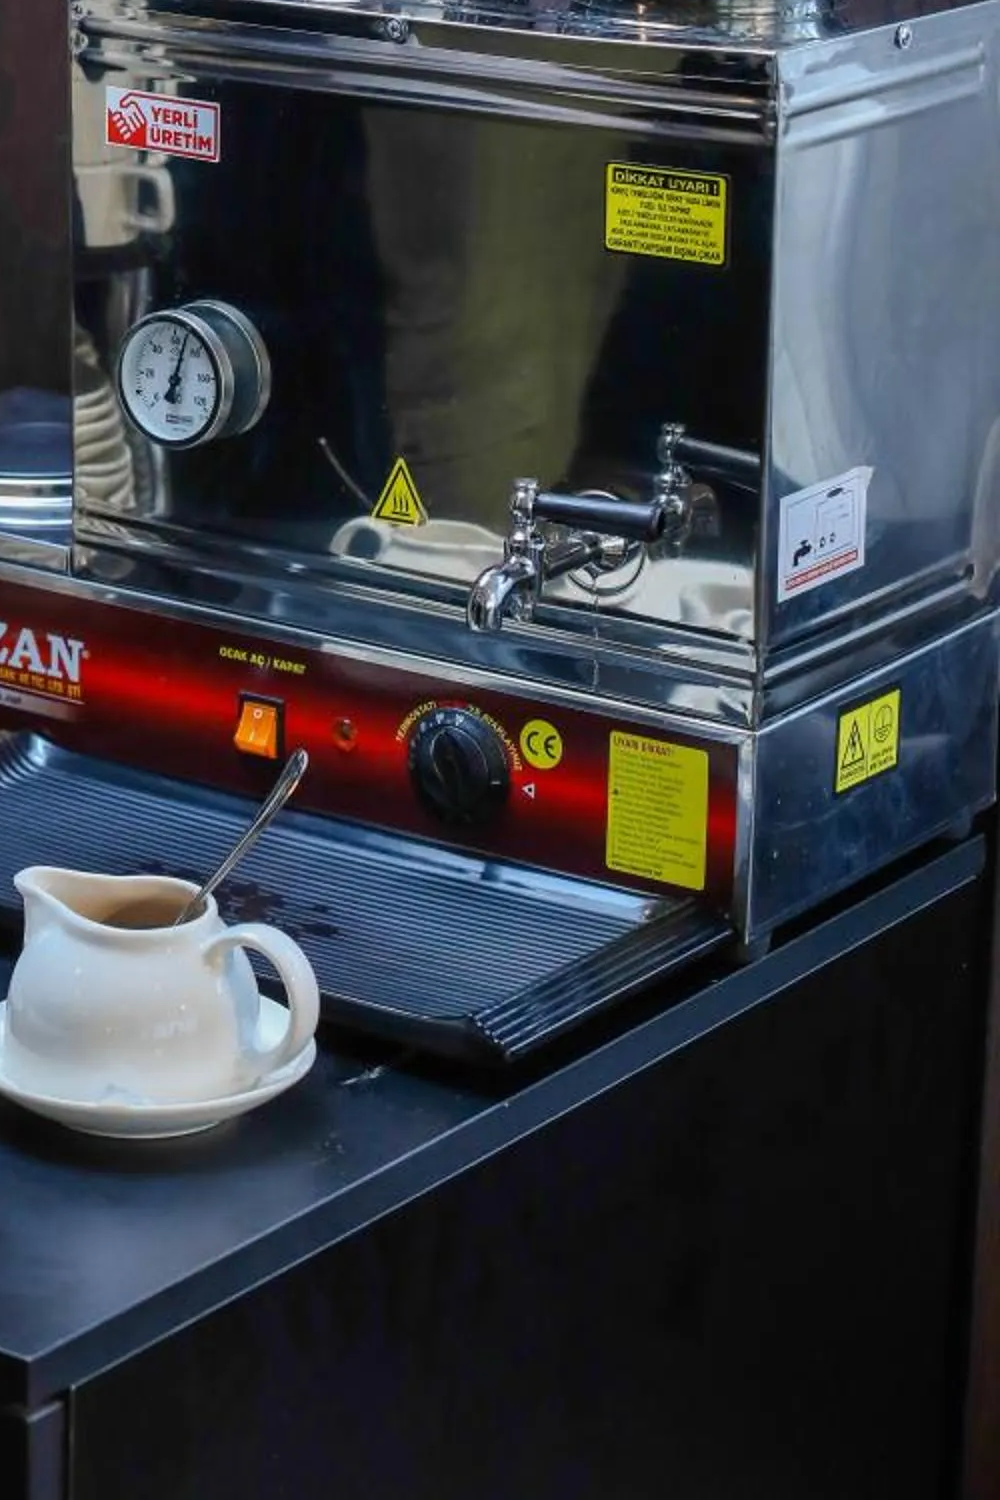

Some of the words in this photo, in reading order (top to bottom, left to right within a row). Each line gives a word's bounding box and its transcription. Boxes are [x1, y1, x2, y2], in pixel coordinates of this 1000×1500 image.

[151, 106, 198, 129] YERLİ
[151, 124, 212, 153] ÜRETİM
[615, 168, 665, 187] DİKKAT
[668, 177, 709, 194] UYARI
